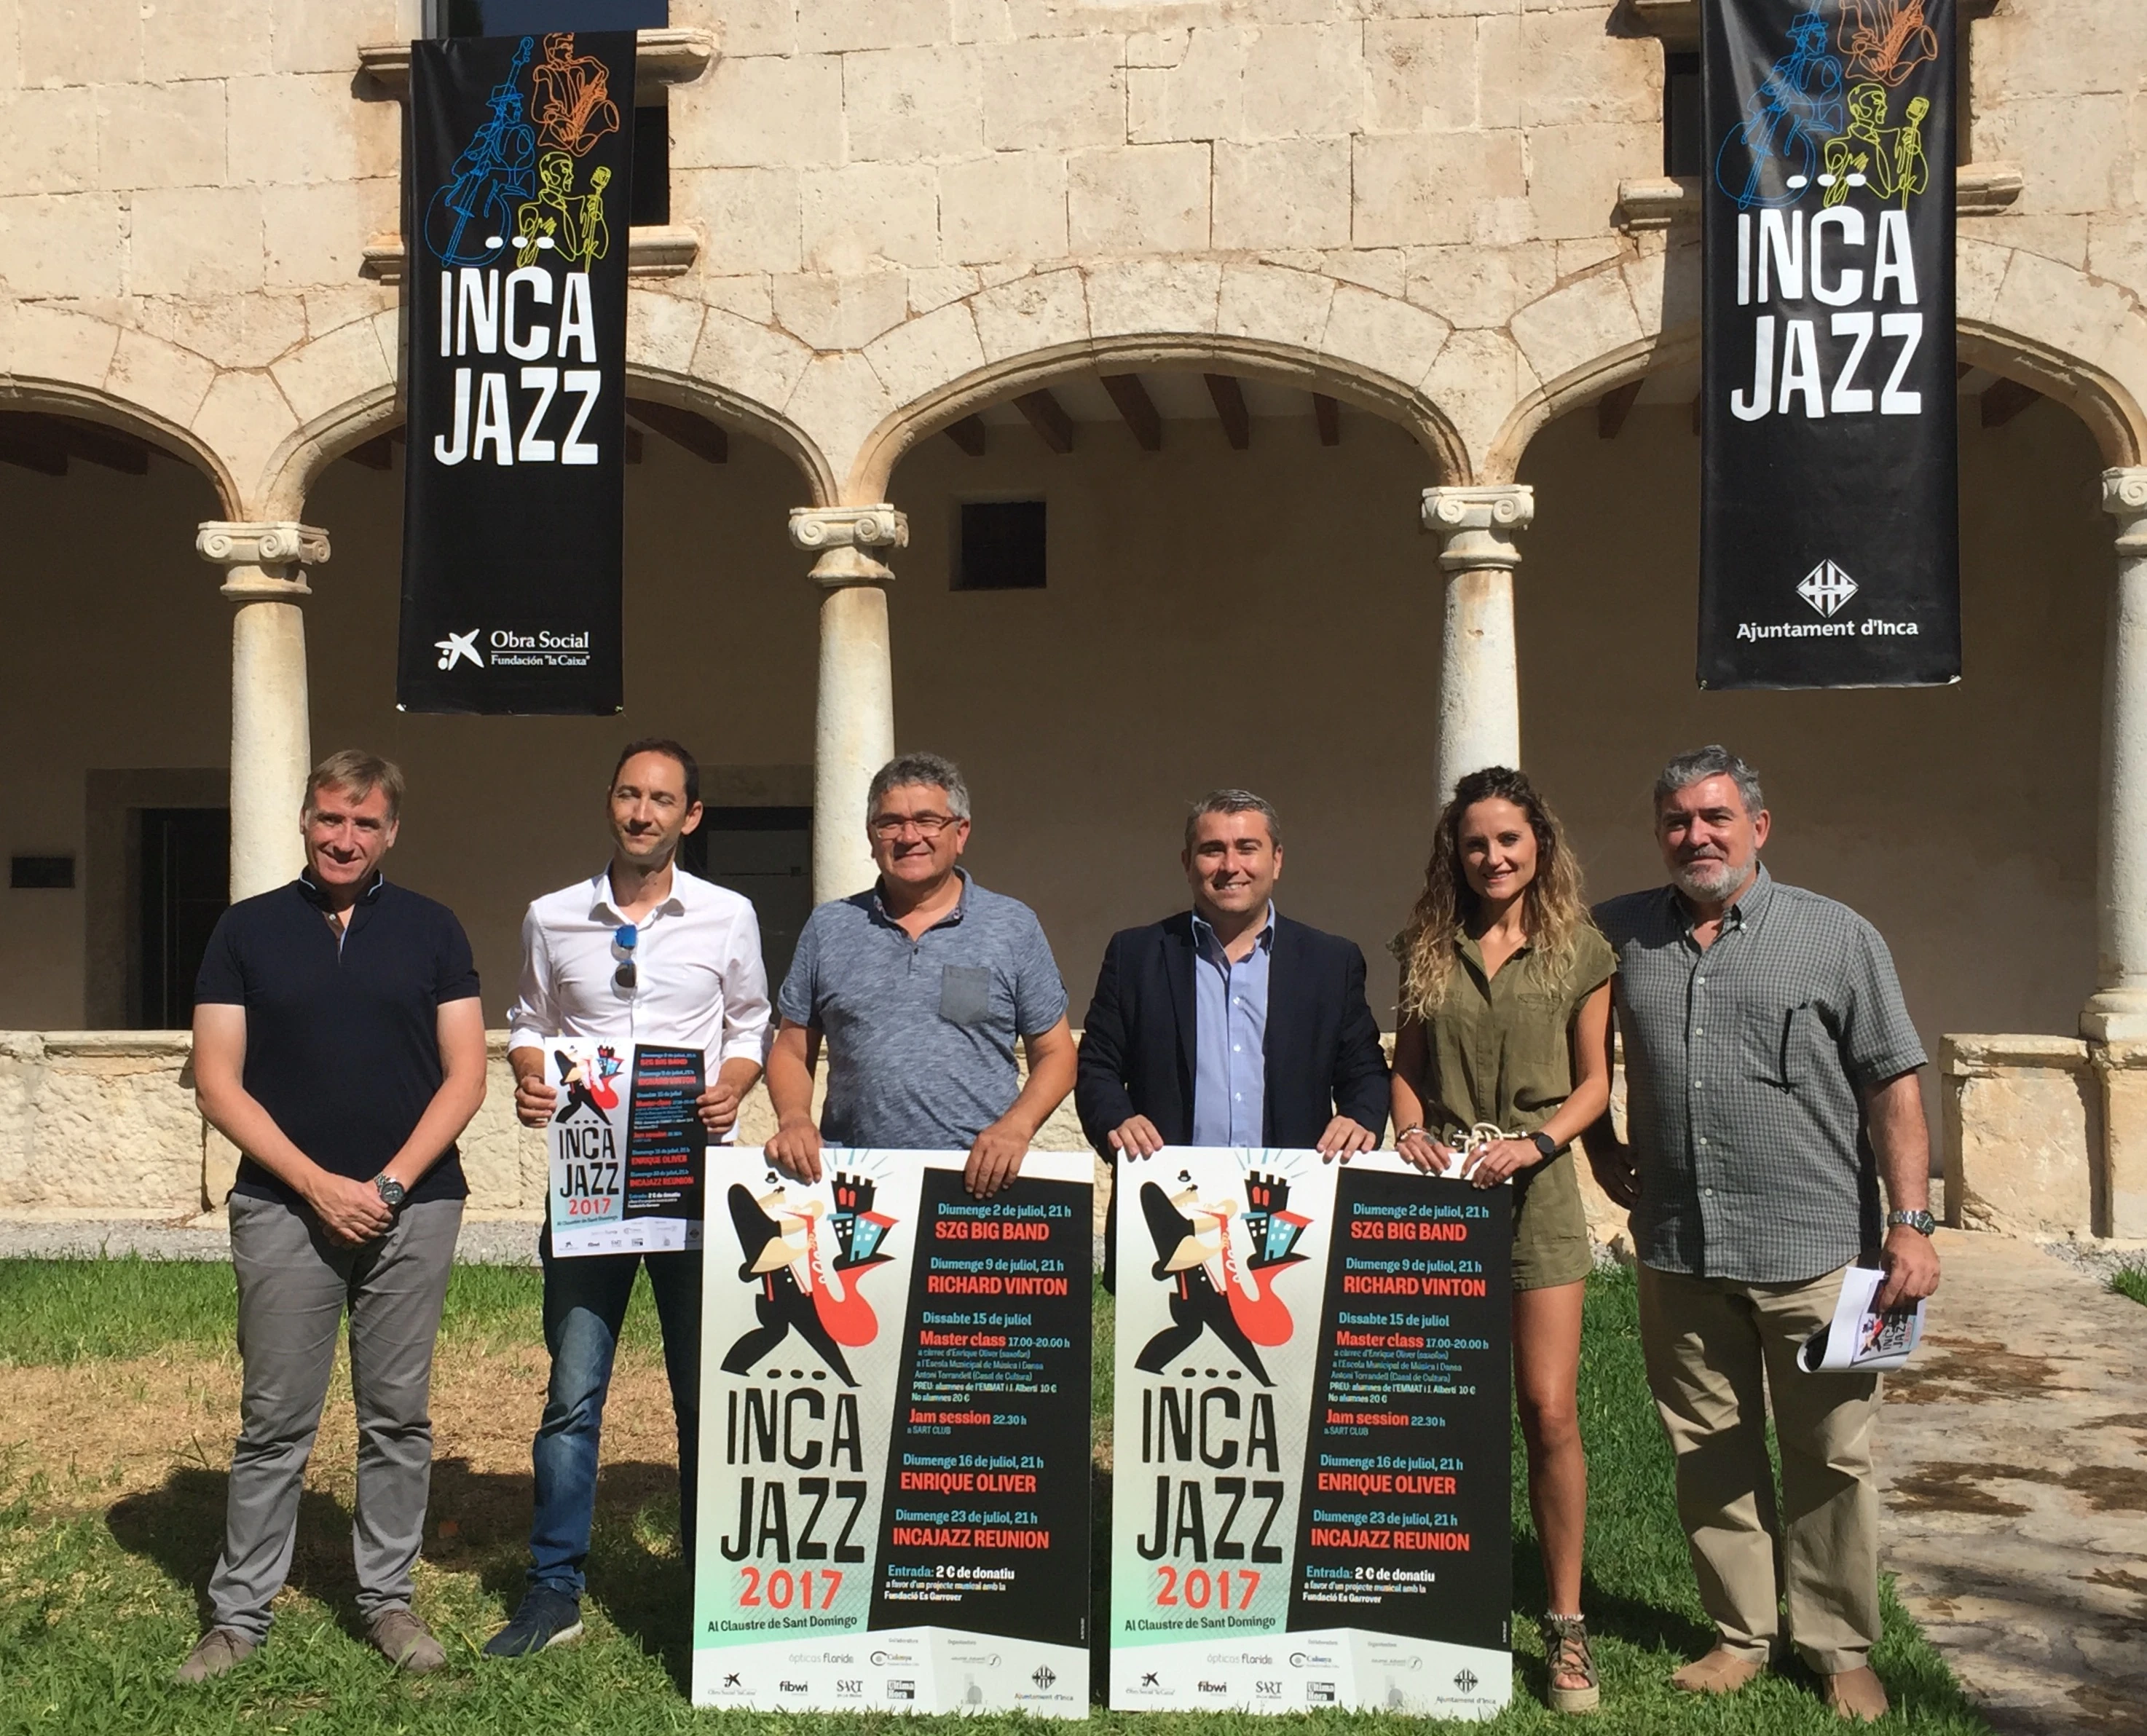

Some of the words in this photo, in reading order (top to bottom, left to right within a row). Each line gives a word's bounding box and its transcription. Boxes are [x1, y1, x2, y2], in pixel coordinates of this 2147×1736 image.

[1738, 205, 1918, 306] INCA
[440, 267, 597, 363] INCA
[1731, 312, 1923, 421] JAZZ
[435, 367, 602, 467] JAZZ
[491, 631, 535, 648] Obra
[539, 631, 588, 648] Social
[1736, 620, 1855, 642] Ajuntament
[1862, 619, 1918, 636] d'Inca
[491, 655, 543, 666] Fundación
[559, 1127, 616, 1160] INCA
[560, 1162, 619, 1198] JAZZ
[569, 1198, 611, 1215] 2017
[938, 1203, 991, 1219] Diumenge
[993, 1204, 1001, 1216] 2
[1002, 1204, 1015, 1217] de
[1017, 1204, 1047, 1219] juliol,
[1049, 1205, 1062, 1217] 21
[1064, 1205, 1071, 1217] h
[1353, 1203, 1407, 1219] Diumenge
[1409, 1204, 1417, 1216] 2
[1419, 1204, 1432, 1217] de
[1434, 1205, 1464, 1220] juliol,
[1465, 1206, 1480, 1218] 21
[1482, 1207, 1489, 1218] h
[935, 1221, 968, 1239] SZG
[971, 1222, 999, 1240] BIG
[1003, 1223, 1049, 1240] BAND
[1351, 1221, 1383, 1239] SZG
[1387, 1222, 1416, 1240] BIG
[1419, 1223, 1467, 1241] BAND
[931, 1257, 983, 1273] Diumenge
[985, 1258, 993, 1270] 9
[995, 1258, 1009, 1271] de
[1010, 1258, 1039, 1273] juliol,
[1041, 1259, 1055, 1271] 21
[1057, 1260, 1063, 1271] h
[1346, 1257, 1400, 1274] Diumenge
[1402, 1259, 1410, 1271] 9
[1411, 1259, 1425, 1271] de
[1427, 1259, 1457, 1274] juliol,
[1459, 1260, 1473, 1272] 21
[1474, 1261, 1482, 1273] h
[928, 1276, 1001, 1294] RICHARD
[1004, 1277, 1068, 1295] VINTON
[1344, 1276, 1419, 1295] RICHARD
[1422, 1279, 1486, 1297] VINTON
[923, 1311, 970, 1325] Dissabte
[973, 1313, 987, 1325] 15
[988, 1312, 1002, 1325] de
[1004, 1313, 1031, 1327] juliol
[1339, 1312, 1387, 1325] Dissabte
[1390, 1314, 1403, 1325] 15
[1406, 1314, 1419, 1326] de
[1421, 1314, 1449, 1328] juliol
[921, 1330, 968, 1346] Master
[970, 1332, 1006, 1347] class
[1064, 1338, 1070, 1348] h
[1336, 1331, 1384, 1346] Master
[1387, 1333, 1424, 1348] class
[1426, 1338, 1481, 1349] 17.00-20.00
[1482, 1340, 1489, 1349] h
[912, 1393, 921, 1401] No
[953, 1394, 962, 1402] 20
[910, 1408, 936, 1424] Jam
[939, 1410, 991, 1425] session
[993, 1415, 1019, 1425] 22.30
[1020, 1416, 1027, 1425] h
[1326, 1409, 1354, 1424] Jam
[1357, 1410, 1409, 1426] session
[1411, 1416, 1438, 1427] 22.30
[1439, 1417, 1446, 1427] h
[728, 1387, 863, 1472] INCA
[913, 1426, 931, 1435] SART
[932, 1427, 951, 1435] CLUB
[1143, 1386, 1280, 1472] INCA
[903, 1453, 957, 1469] Diumenge
[958, 1455, 972, 1467] 16
[974, 1455, 988, 1467] de
[989, 1456, 1019, 1469] juliol,
[1021, 1456, 1035, 1468] 21
[1036, 1456, 1044, 1469] h
[1320, 1454, 1375, 1470] Diumenge
[1376, 1456, 1390, 1468] 16
[1393, 1456, 1406, 1469] de
[1408, 1457, 1438, 1472] juliol,
[1441, 1459, 1454, 1470] 21
[1457, 1459, 1463, 1471] h
[901, 1472, 973, 1494] ENRIQUE
[977, 1474, 1036, 1493] OLIVER
[1318, 1473, 1392, 1496] ENRIQUE
[1395, 1475, 1456, 1494] OLIVER
[721, 1477, 867, 1563] JAZZ
[896, 1509, 949, 1524] Diumenge
[951, 1510, 966, 1523] 23
[968, 1511, 981, 1523] de
[982, 1511, 1012, 1526] juliol,
[1015, 1512, 1028, 1524] 21
[1030, 1512, 1037, 1524] h
[1137, 1475, 1284, 1563] JAZZ
[1313, 1510, 1367, 1526] Diumenge
[1370, 1512, 1384, 1523] 23
[1387, 1512, 1400, 1524] de
[1402, 1512, 1432, 1527] juliol,
[1435, 1514, 1448, 1526] 21
[1451, 1514, 1457, 1526] h
[893, 1528, 971, 1547] INCAJAZZ
[974, 1530, 1049, 1549] REUNION
[1311, 1528, 1390, 1548] INCAJAZZ
[1393, 1531, 1470, 1551] REUNION
[888, 1565, 934, 1577] Entrada:
[936, 1566, 944, 1577] 2
[957, 1566, 970, 1579] de
[973, 1566, 1015, 1580] donatiu
[1307, 1565, 1352, 1579] Entrada:
[1355, 1567, 1363, 1579] 2
[1376, 1568, 1390, 1580] de
[1392, 1569, 1435, 1582] donatiu
[740, 1566, 843, 1609] 2017
[884, 1592, 918, 1601] Fundació
[919, 1593, 928, 1601] Es
[1157, 1566, 1261, 1610] 2017
[708, 1621, 720, 1632] Al
[721, 1618, 765, 1630] Claustre
[768, 1617, 781, 1629] de
[783, 1616, 808, 1628] Sant
[810, 1615, 857, 1629] Domingo
[1124, 1620, 1136, 1631] Al
[1138, 1618, 1183, 1630] Claustre
[1186, 1617, 1199, 1629] de
[1201, 1616, 1225, 1628] Sant
[1228, 1615, 1275, 1629] Domingo
[779, 1681, 808, 1692] fibwi
[1197, 1681, 1226, 1693] fibwi
